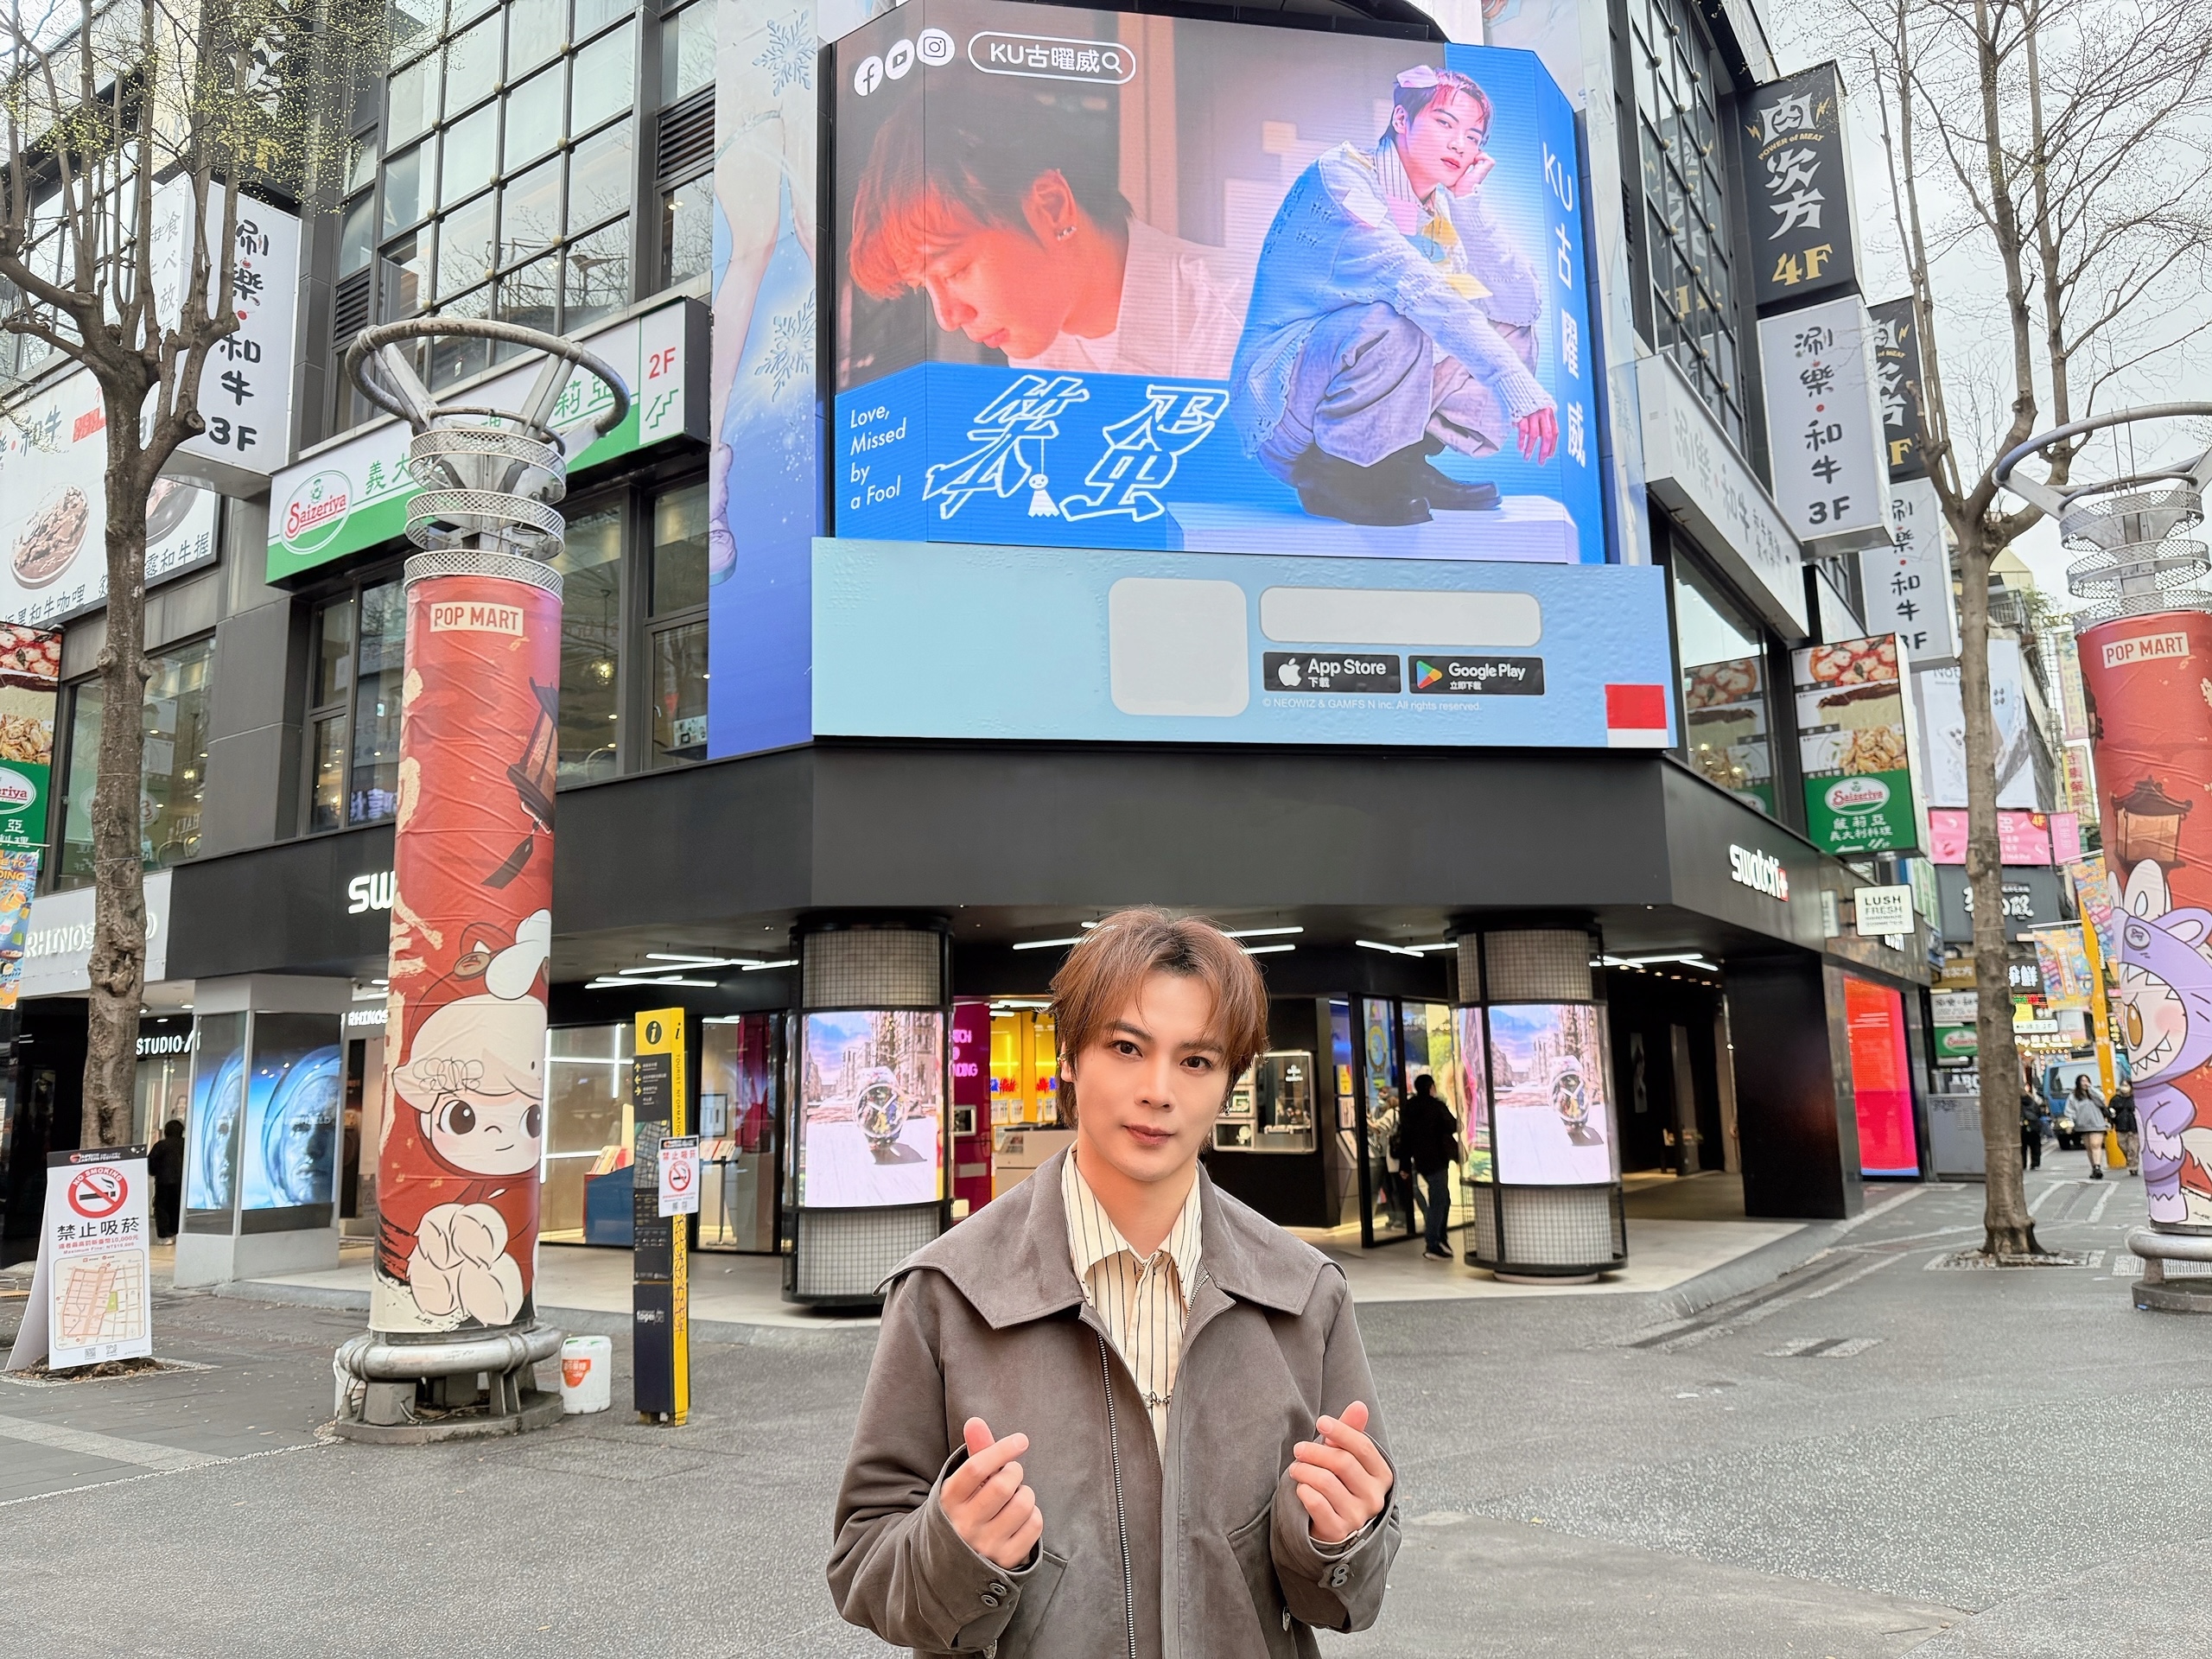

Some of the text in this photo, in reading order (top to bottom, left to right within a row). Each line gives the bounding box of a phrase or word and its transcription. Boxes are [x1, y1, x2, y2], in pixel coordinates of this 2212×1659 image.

[989, 42, 1101, 74] KU古曜威
[1758, 137, 1789, 161] POWER
[1799, 132, 1825, 143] MEAT
[1771, 243, 1834, 286] 4F
[649, 346, 677, 379] 2F
[554, 373, 614, 417] 莉亞
[850, 406, 890, 429] Love,
[208, 416, 257, 452] 3F
[850, 416, 906, 456] Missed
[1889, 437, 1913, 467] F
[850, 462, 870, 486] by
[850, 474, 900, 510] a Fool
[285, 493, 346, 539] Saizeriya
[1808, 495, 1850, 524] 3F
[434, 607, 519, 631] POP MART
[2107, 636, 2183, 664] POP MART
[1307, 658, 1386, 677] App Store
[1448, 662, 1526, 681] Google Play
[1307, 677, 1330, 689] 下載
[1449, 680, 1482, 691] 立即下載
[1274, 698, 1315, 709] NEOWIZ
[1318, 699, 1325, 709] &
[1396, 700, 1408, 709] All
[1411, 701, 1436, 712] rights
[1440, 702, 1482, 711] reserved.
[0, 785, 28, 800] eriya
[0, 870, 26, 881] DING
[1729, 843, 1781, 899] swatch
[1865, 895, 1902, 906] LUSH
[347, 1008, 389, 1027] RHINOS
[136, 1034, 183, 1056] STUDIO
[73, 1167, 123, 1186] NO SMOKING
[57, 1217, 139, 1241] 禁止吸菸
